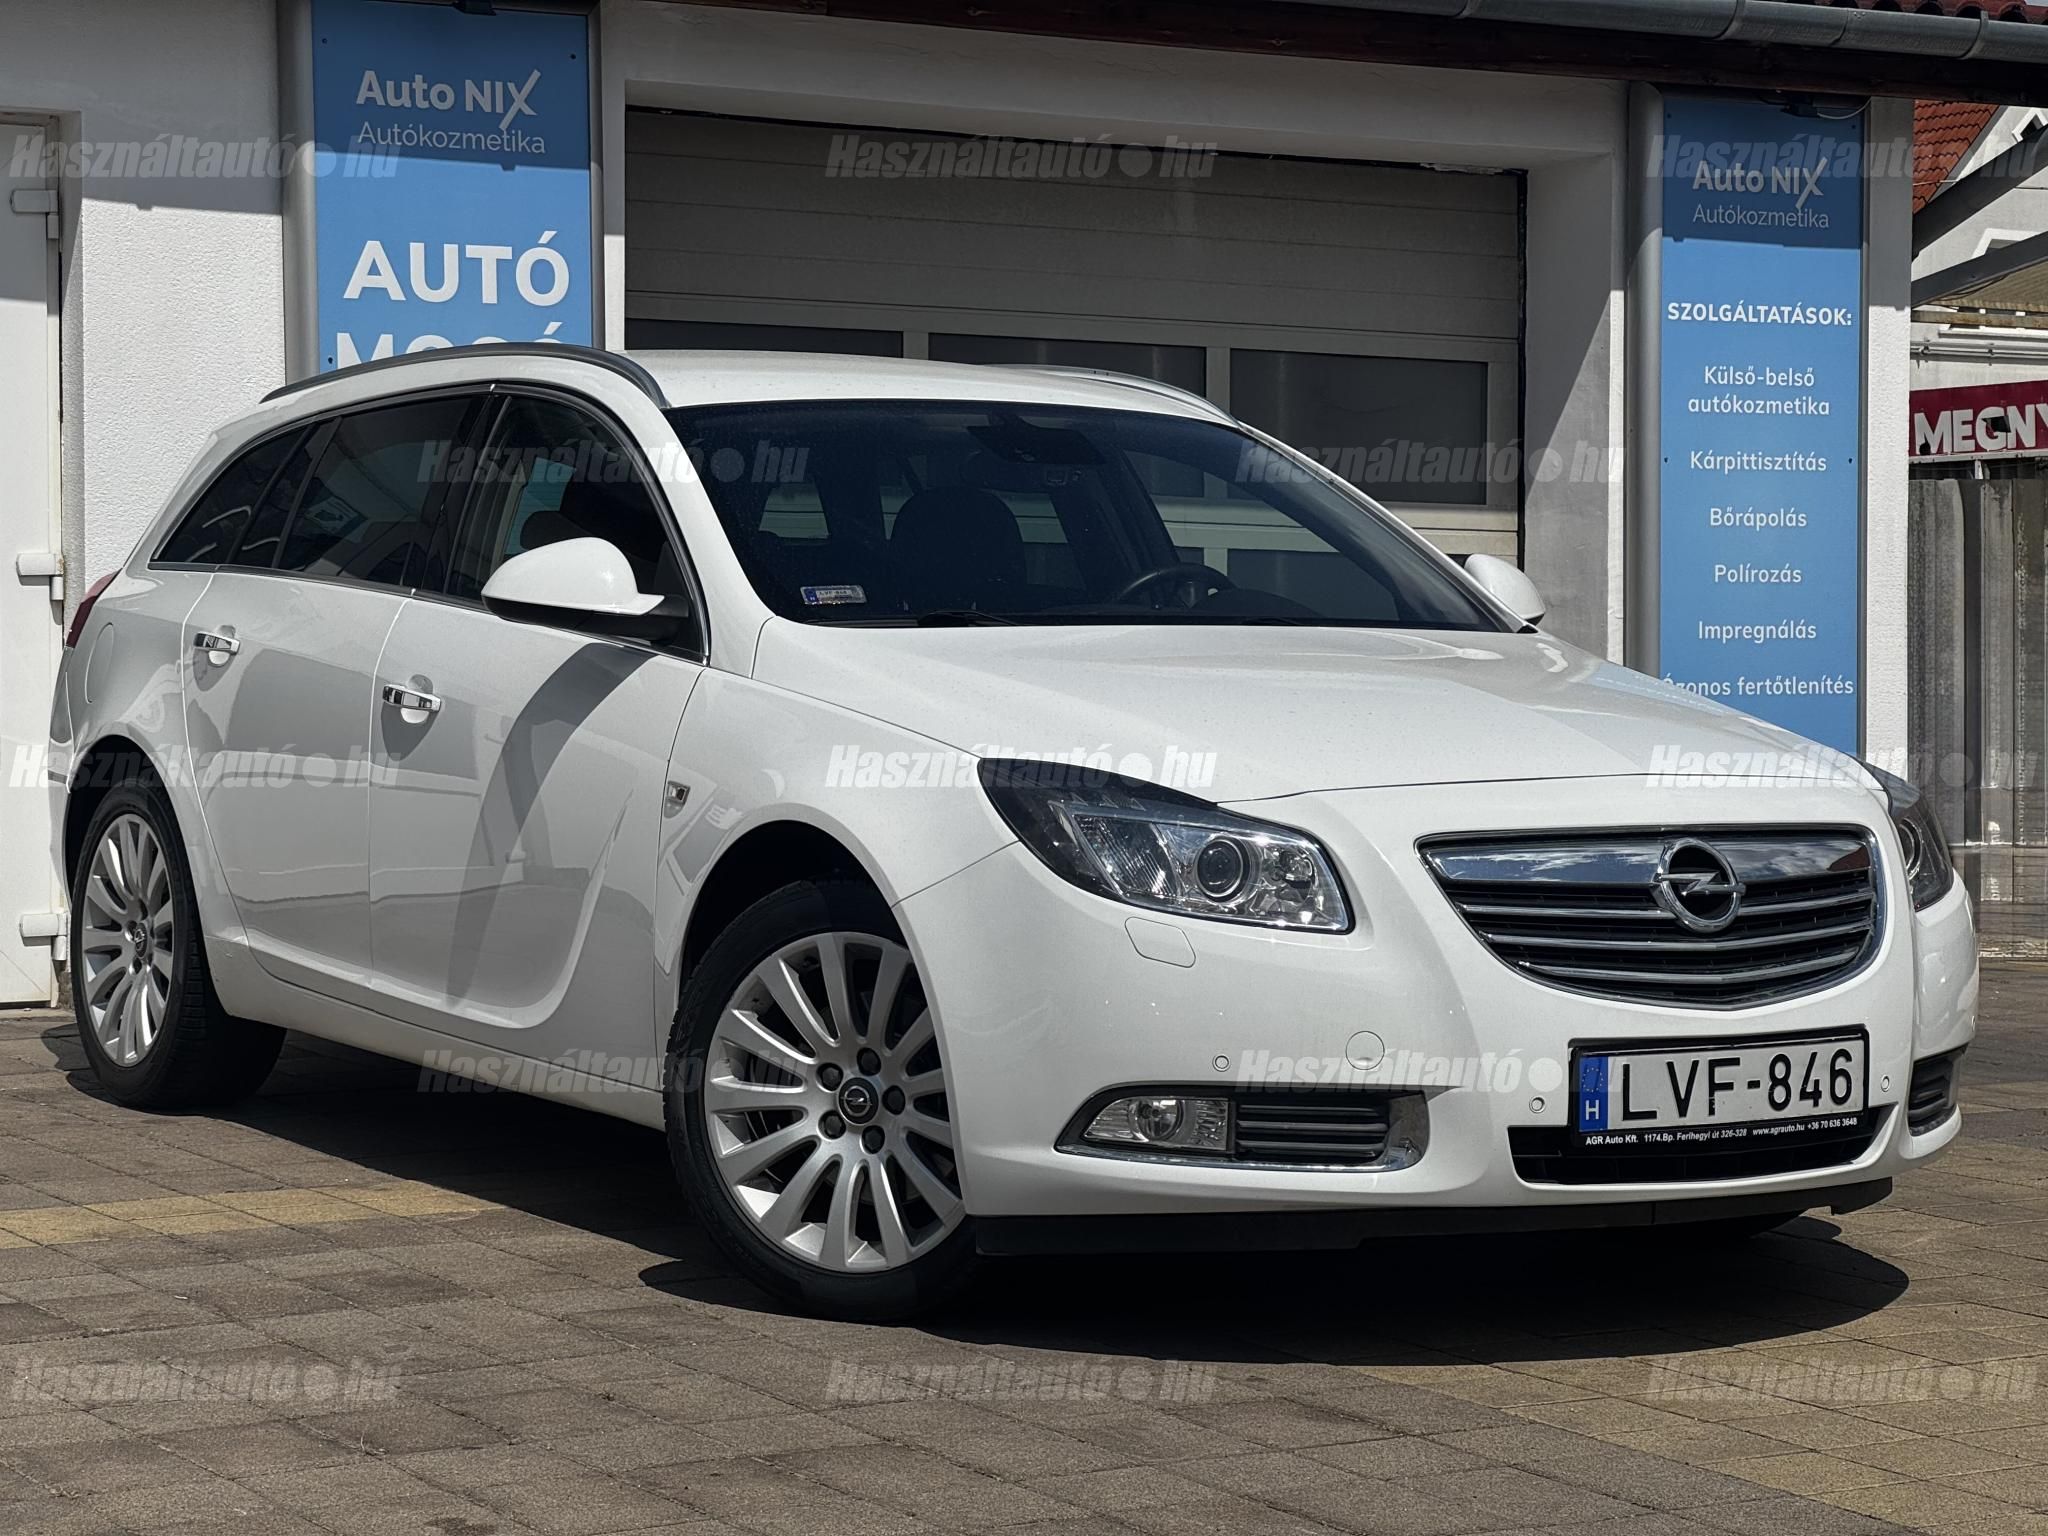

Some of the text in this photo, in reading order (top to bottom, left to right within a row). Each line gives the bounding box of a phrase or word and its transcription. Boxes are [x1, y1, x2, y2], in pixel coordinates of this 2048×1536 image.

[356, 69, 541, 129] Auto NIX
[358, 121, 546, 154] Autókozmetika
[1693, 156, 1828, 209] Auto NIX
[1693, 204, 1829, 228] Autókozmetika
[343, 230, 570, 306] AUTÓ
[1667, 300, 1852, 326] SZOLGÁLTATÁSOK:
[1704, 365, 1814, 387] Külső-belső
[1688, 395, 1830, 417] autókozmetika
[1690, 451, 1827, 475] Kárpittisztítás
[1710, 507, 1807, 531] Bőrápolás
[1714, 564, 1802, 583] Polírozás
[1699, 620, 1818, 643] Impregnálás
[1737, 675, 1855, 695] fertőtlenítés
[1586, 1048, 1854, 1121] H LVF-846
[1585, 1135, 1604, 1146] AGR
[1604, 1134, 1624, 1144] Auto
